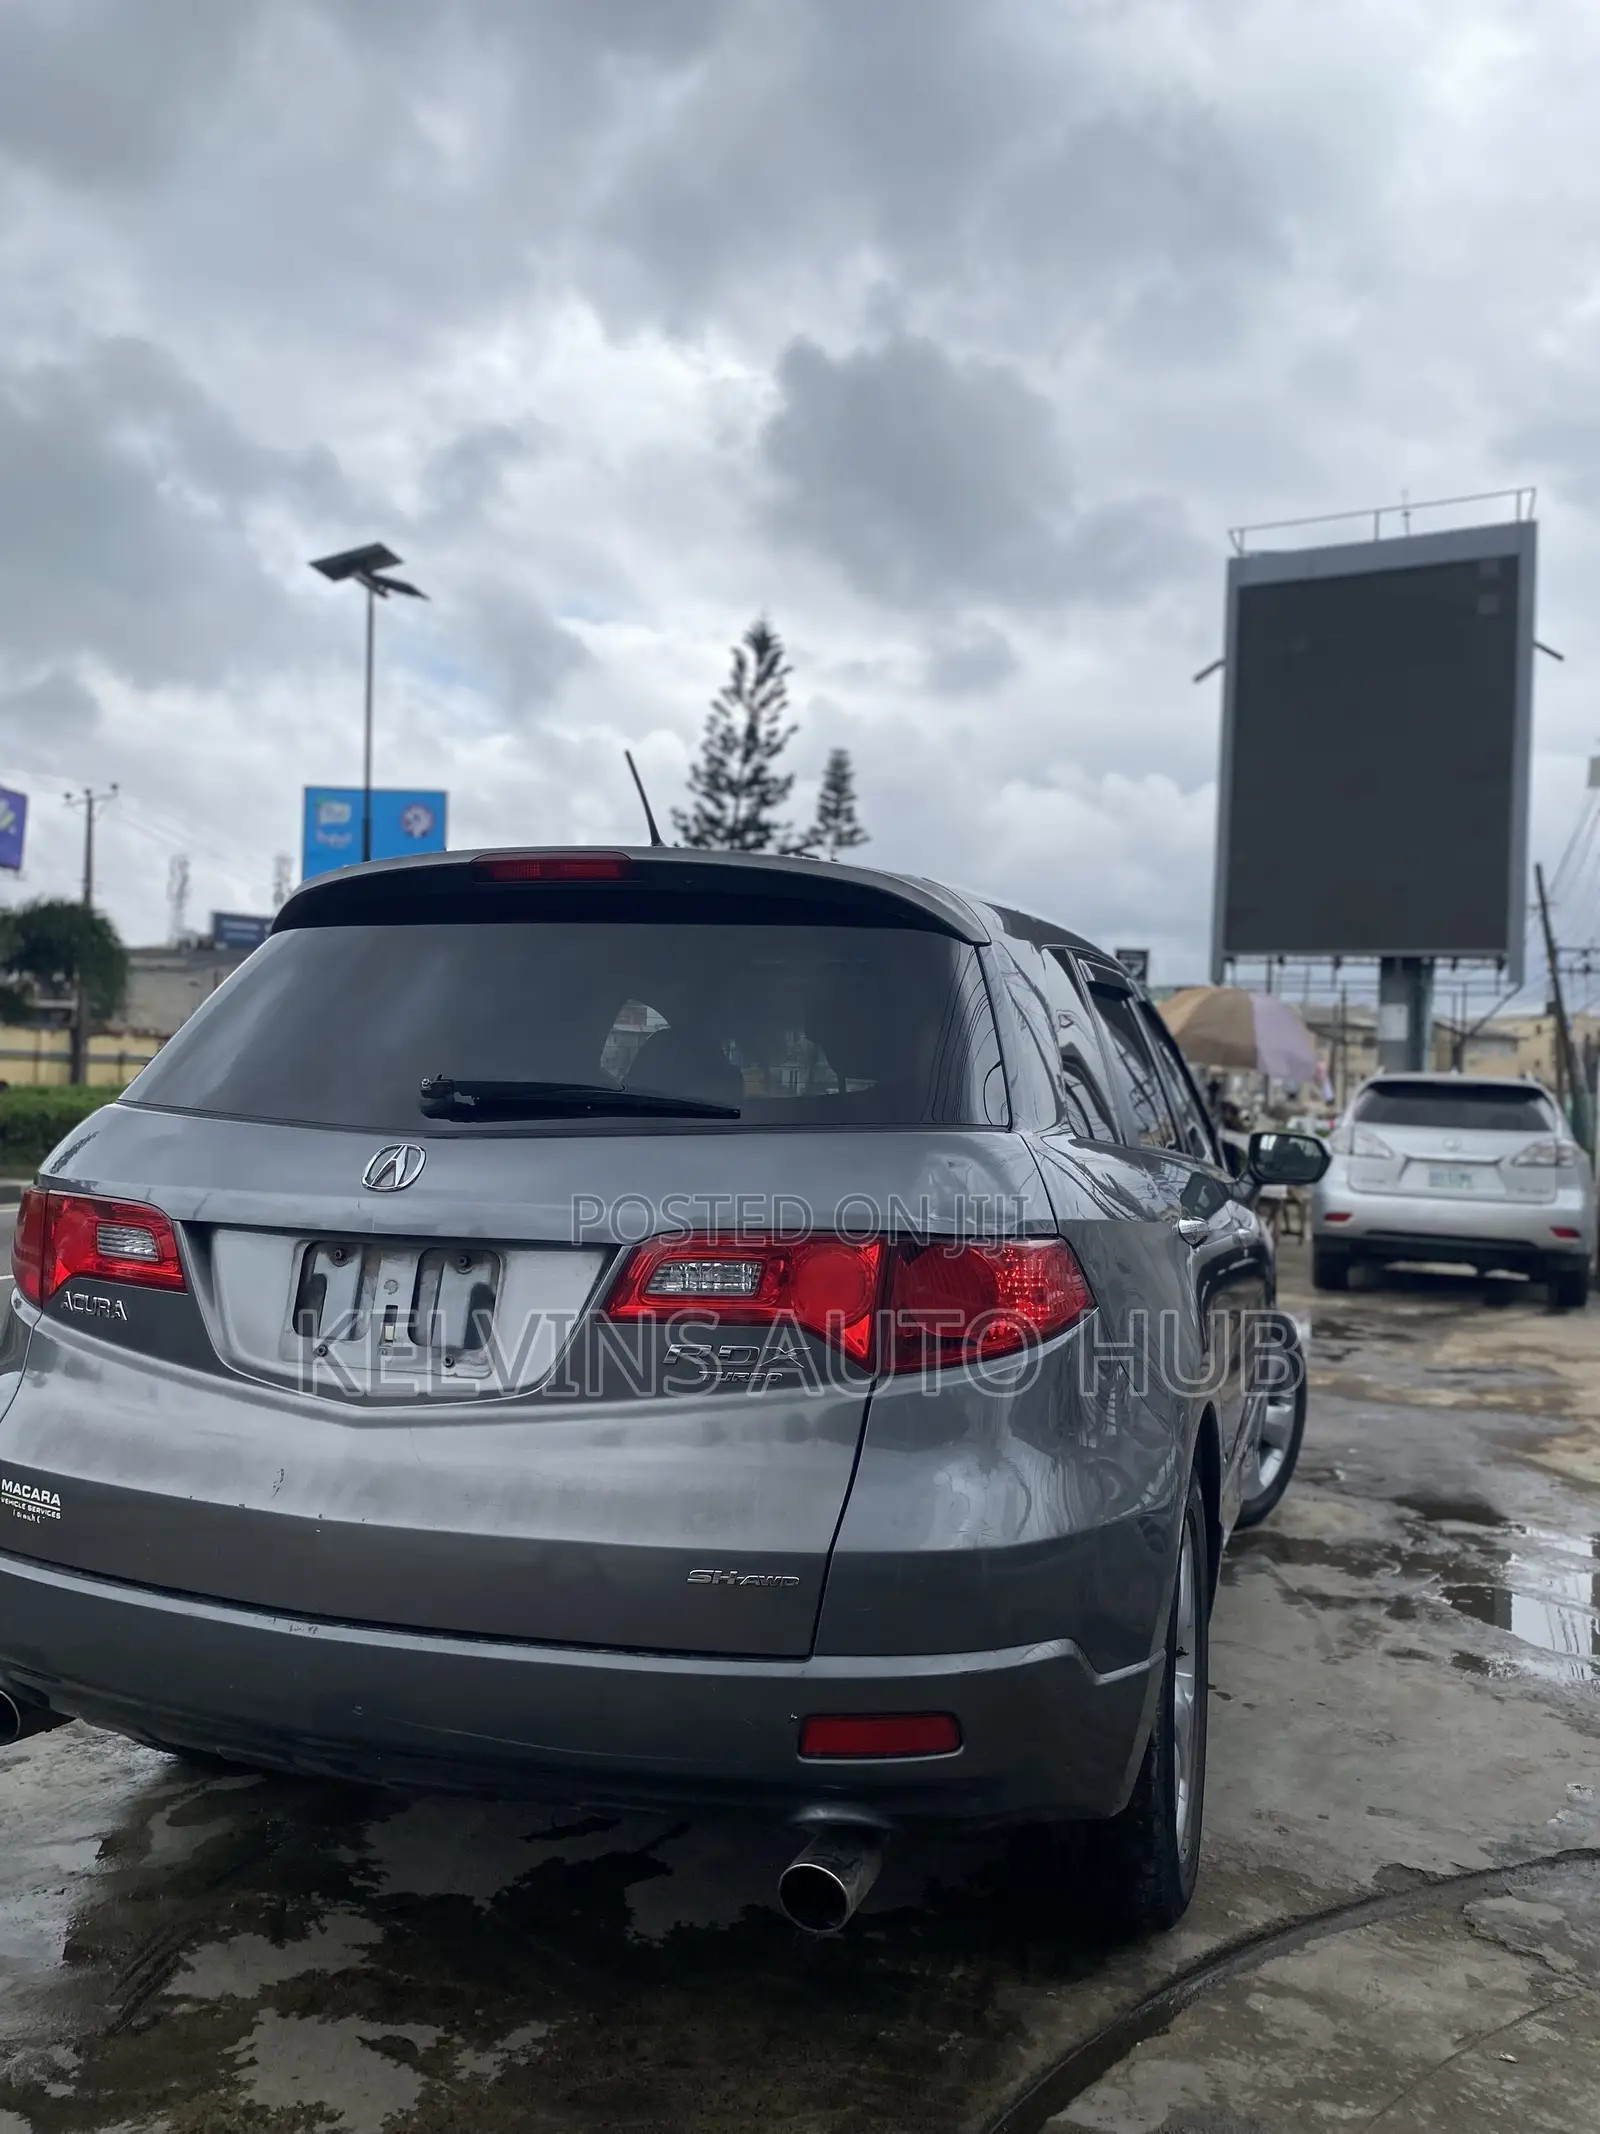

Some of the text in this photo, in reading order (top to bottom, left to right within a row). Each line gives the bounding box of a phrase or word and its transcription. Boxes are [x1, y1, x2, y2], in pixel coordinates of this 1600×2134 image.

[61, 1291, 128, 1321] ACURA
[663, 1344, 811, 1369] RDX
[699, 1371, 783, 1384] TURBO
[1, 1478, 61, 1507] MACARA
[1, 1496, 27, 1510] VEHICLE
[27, 1504, 61, 1520] SERVICES
[686, 1569, 800, 1587] SH-AWD
